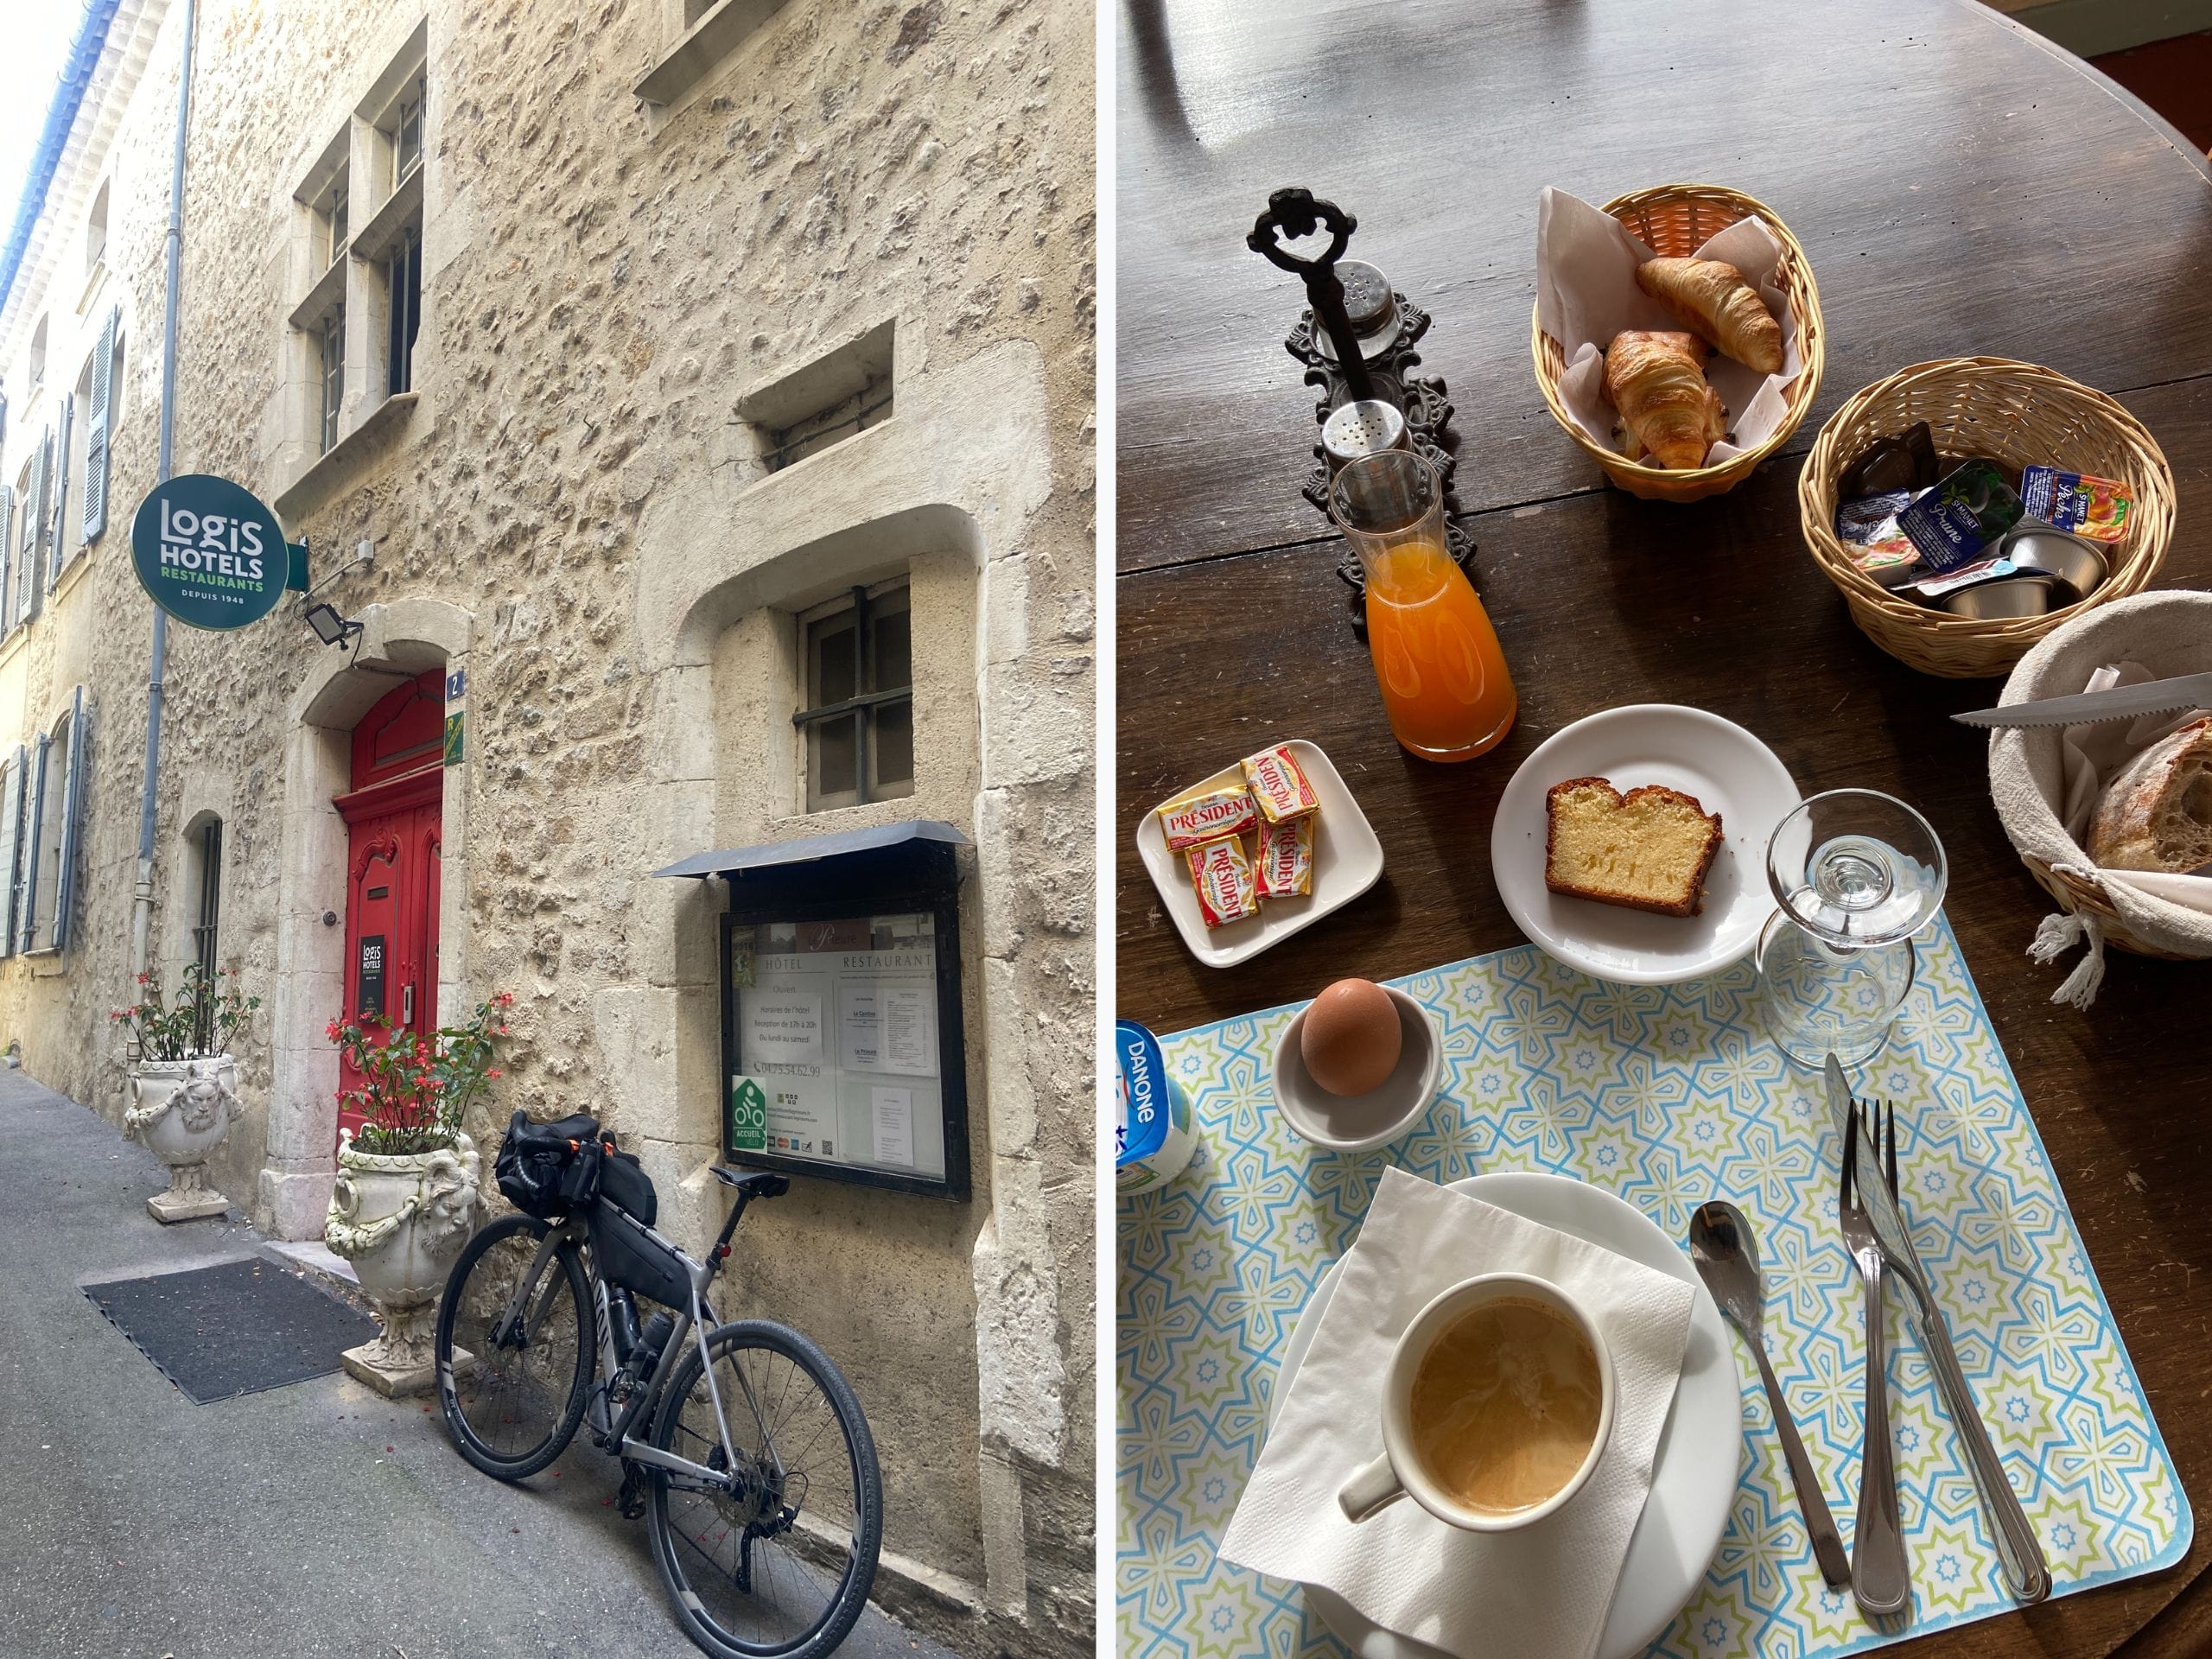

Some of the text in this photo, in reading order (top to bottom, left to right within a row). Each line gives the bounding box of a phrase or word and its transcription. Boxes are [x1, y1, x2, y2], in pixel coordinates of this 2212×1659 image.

[2055, 483, 2074, 518] Pêche
[1929, 503, 1962, 543] Prune
[1957, 505, 1979, 529] MAMET
[161, 544, 264, 579] HOTELS
[161, 566, 264, 592] RESTAURANTS
[181, 589, 244, 604] DEPUIS 1948
[452, 676, 458, 696] 2
[1255, 757, 1294, 810] PRÉSIDEN
[1170, 796, 1252, 830] PRÉSIDENT
[1276, 823, 1298, 894] PRÉSIDENT
[1211, 848, 1243, 918] PRÉSIDENT
[363, 960, 381, 969] HOTELS
[766, 957, 803, 969] HÔTEL
[843, 954, 931, 968] RESTAURANT
[784, 1006, 791, 1014] de
[789, 1020, 800, 1029] 17h
[805, 1020, 817, 1029] 20h
[790, 1035, 810, 1044] samedi
